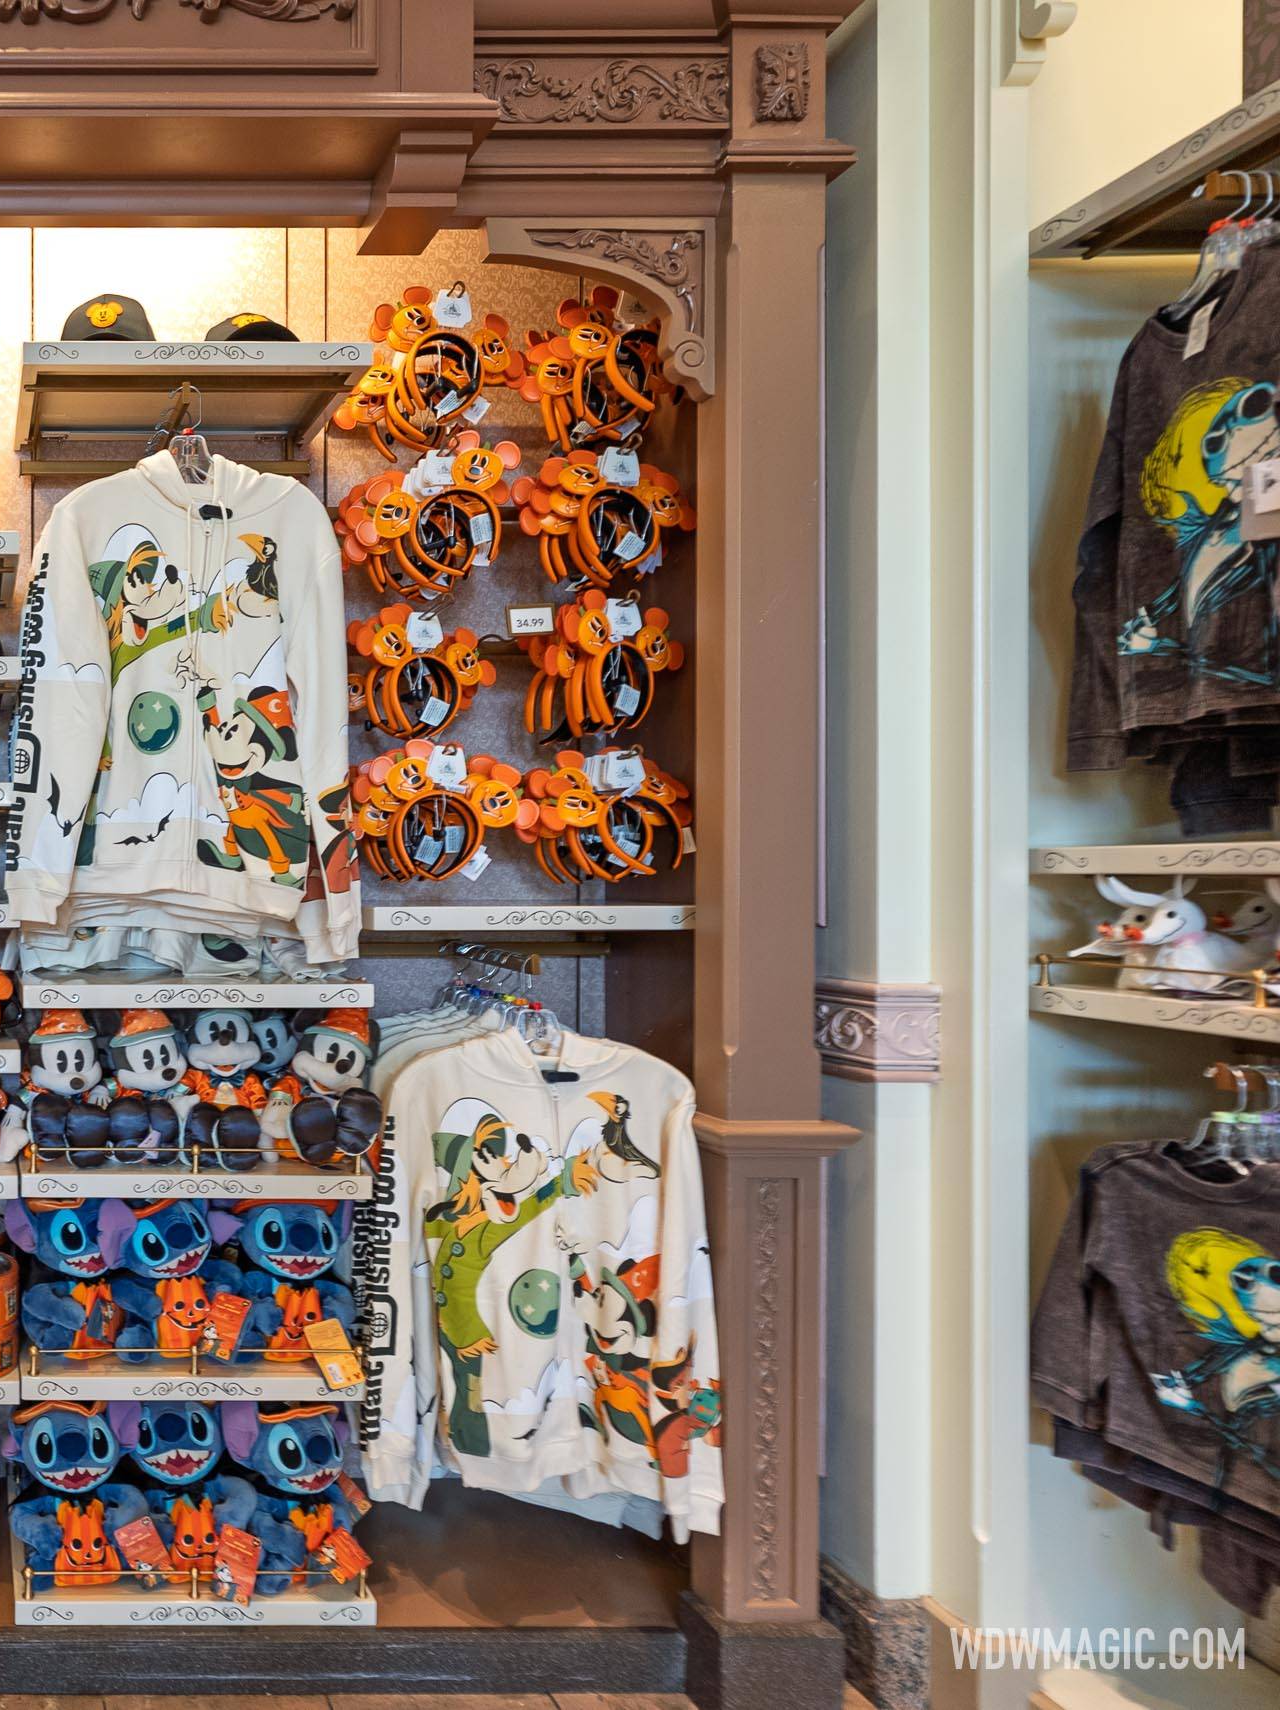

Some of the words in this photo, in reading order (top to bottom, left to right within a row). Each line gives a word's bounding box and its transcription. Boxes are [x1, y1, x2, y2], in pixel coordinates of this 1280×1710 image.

[516, 618, 544, 628] 34.99
[13, 648, 46, 793] Disney
[366, 1210, 400, 1356] Disney
